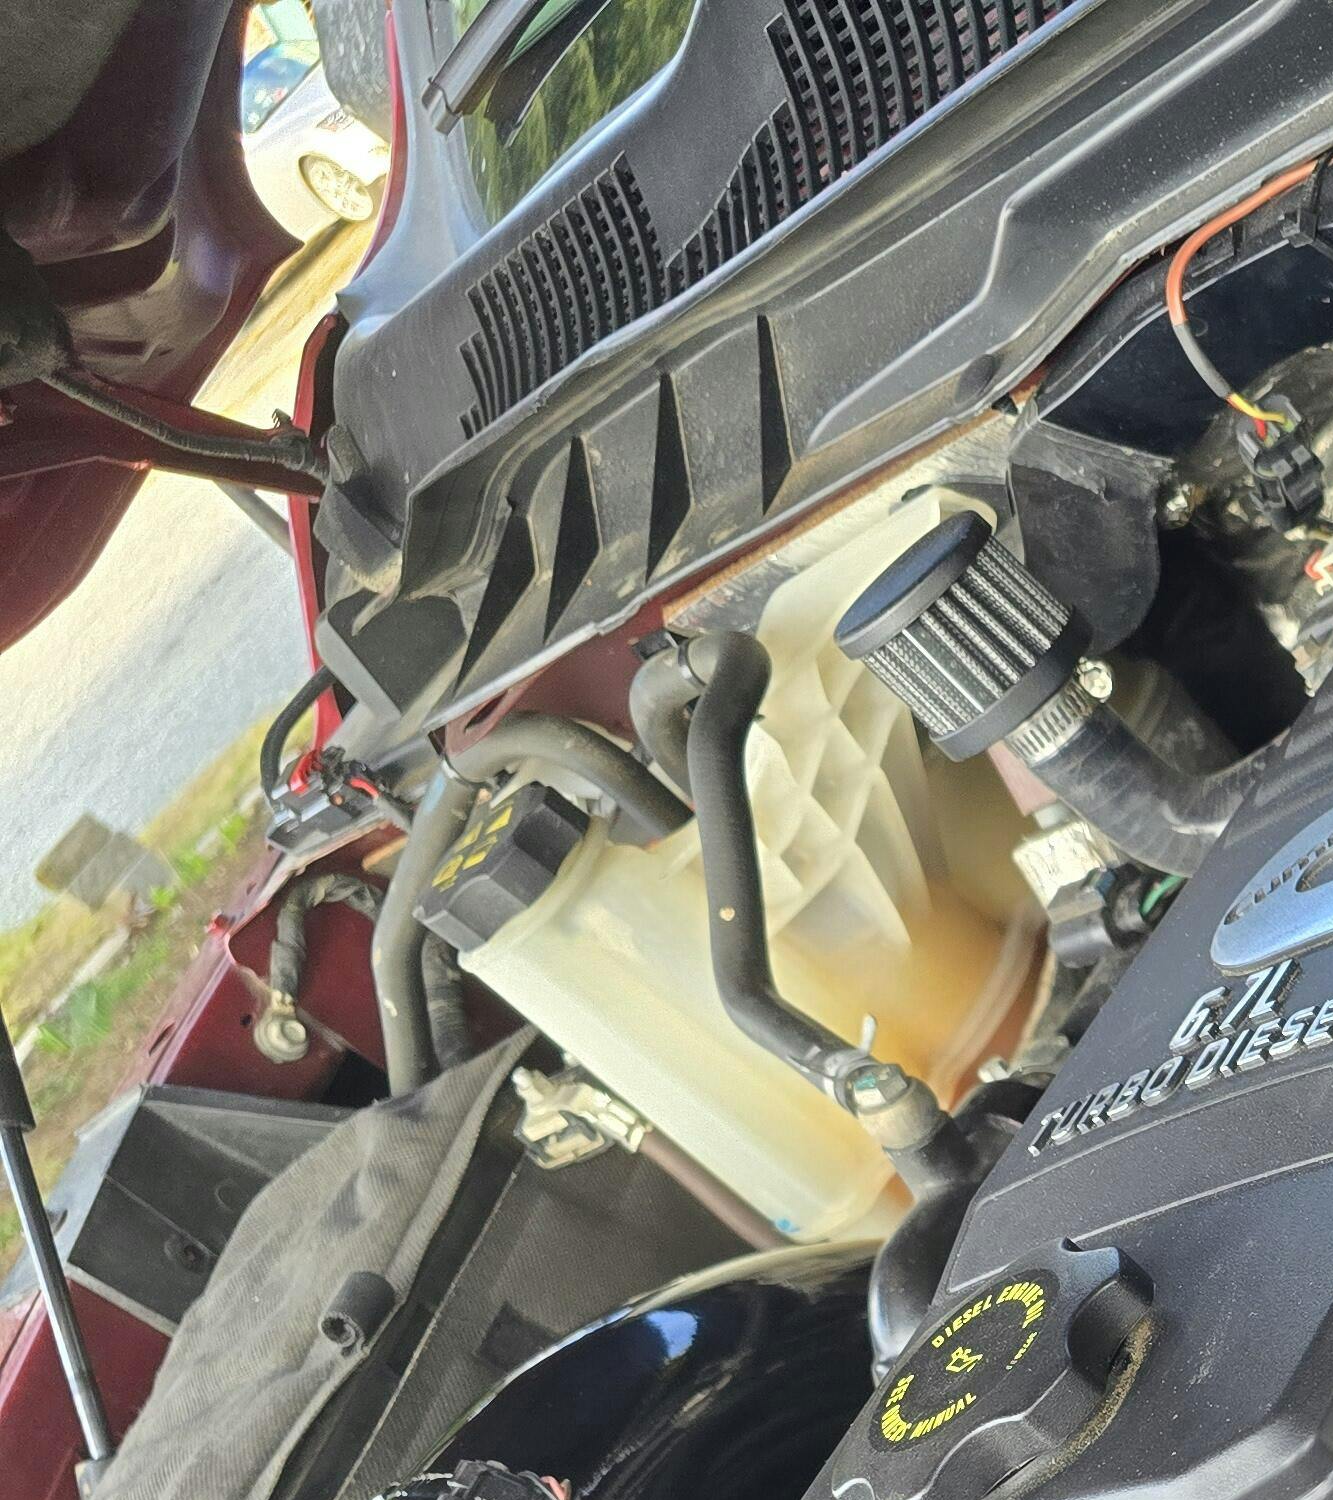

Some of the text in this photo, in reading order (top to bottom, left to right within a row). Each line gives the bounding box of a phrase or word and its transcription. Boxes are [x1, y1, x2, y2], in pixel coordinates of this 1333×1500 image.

[1169, 958, 1297, 1053] 6.7L
[1028, 1055, 1189, 1156] TURBO
[932, 1295, 992, 1348] DIESEL
[996, 1281, 1043, 1307] ENGINE
[886, 1374, 914, 1407] SEE
[909, 1393, 976, 1440] MANUAL
